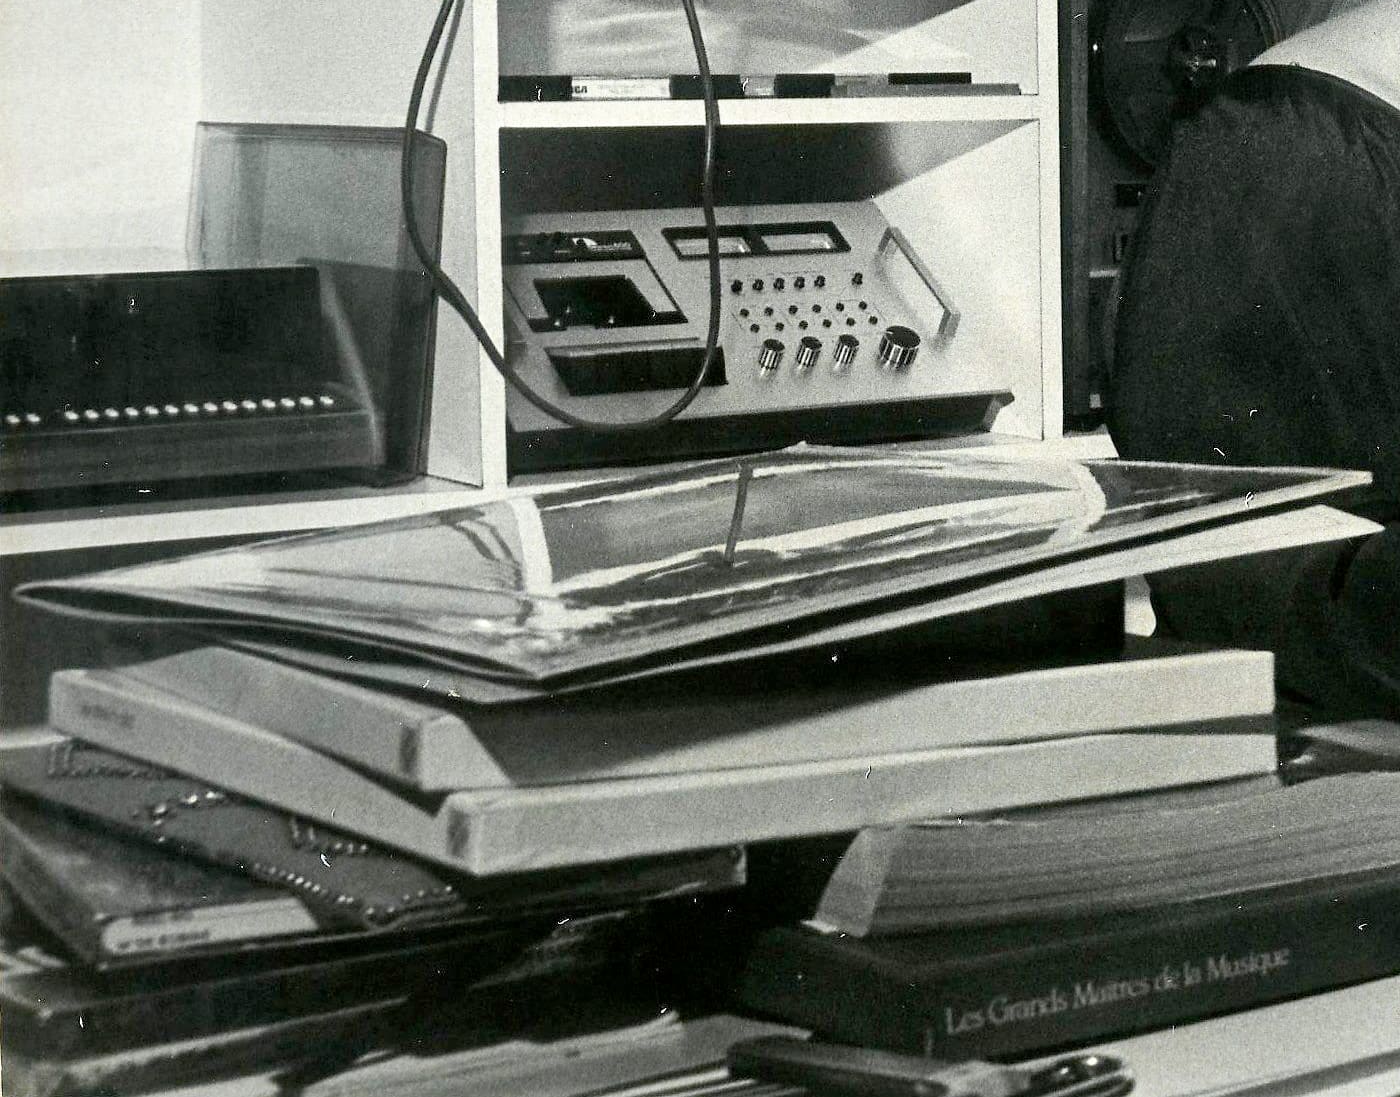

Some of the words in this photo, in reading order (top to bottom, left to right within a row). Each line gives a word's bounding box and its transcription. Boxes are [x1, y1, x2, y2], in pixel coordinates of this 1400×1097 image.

[945, 1006, 986, 1035] Les
[987, 986, 1069, 1025] Grands
[1154, 963, 1181, 991] de
[1183, 959, 1202, 987] la
[1206, 948, 1290, 984] Musique
